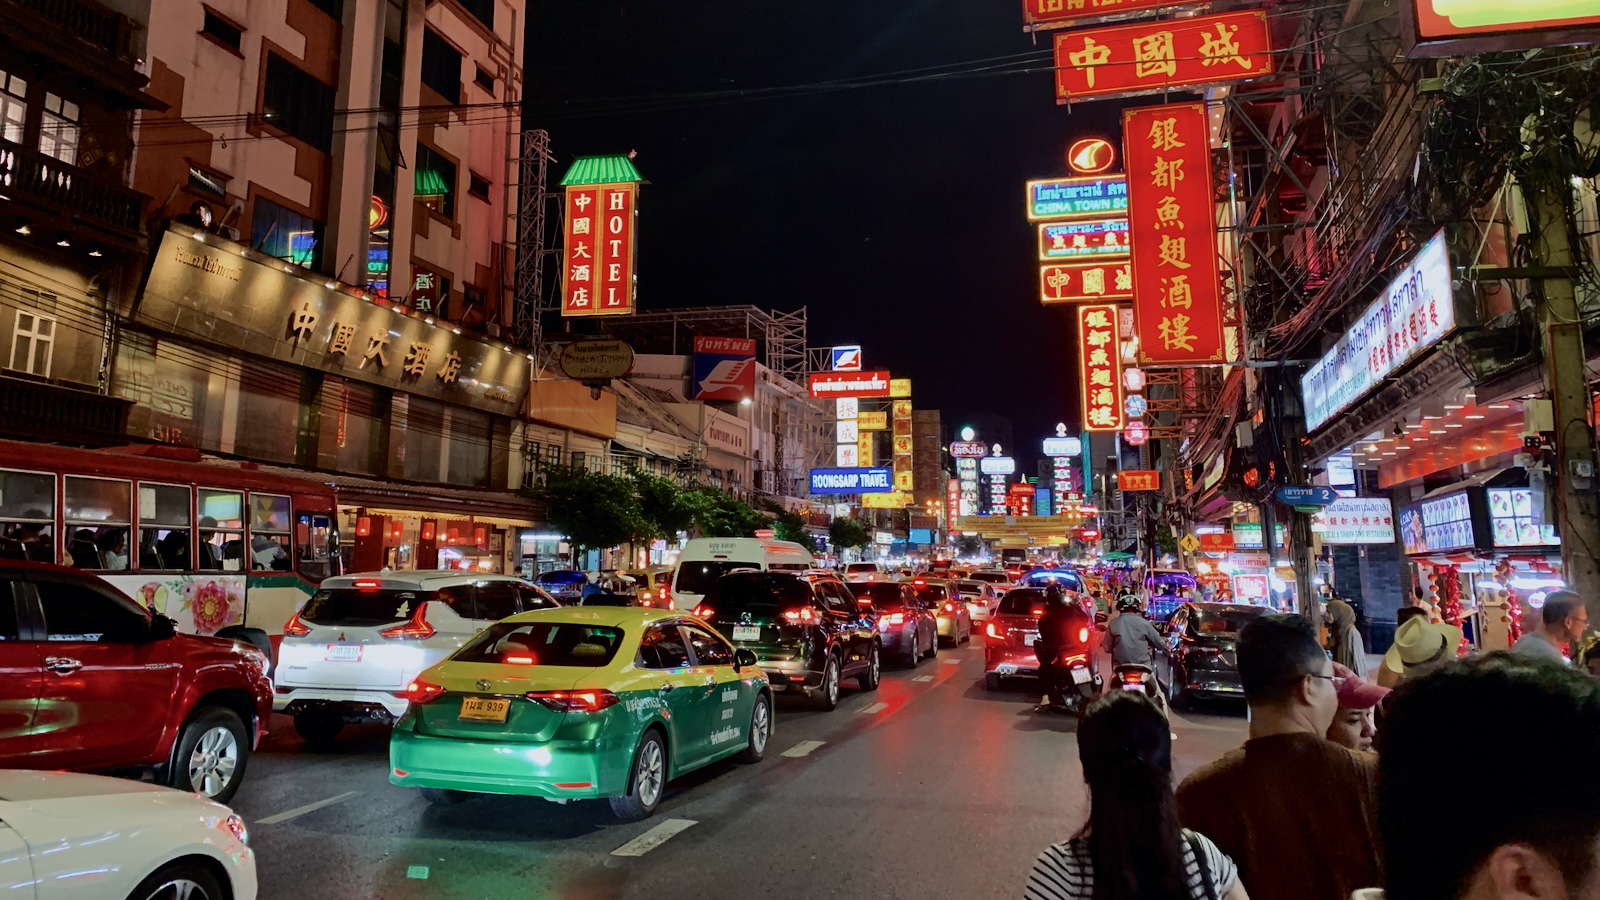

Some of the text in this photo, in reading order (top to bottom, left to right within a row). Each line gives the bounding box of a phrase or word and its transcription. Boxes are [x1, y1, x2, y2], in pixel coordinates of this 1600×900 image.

[1069, 22, 1252, 89] 中國城
[1034, 202, 1072, 214] CHINA
[1074, 199, 1110, 211] TOWN
[1147, 117, 1198, 352] 銀都魚翅酒樓
[569, 193, 592, 307] 中國大酒店
[608, 192, 625, 306] HOTEL
[293, 302, 462, 384] 中國大酒店
[1084, 310, 1118, 426] 銀都魚翅酒樓
[812, 473, 889, 488] ROONGSARP TRAVEL
[1284, 488, 1330, 500] เยาวราช 2
[344, 647, 359, 655] 3616
[486, 701, 504, 712] 939
